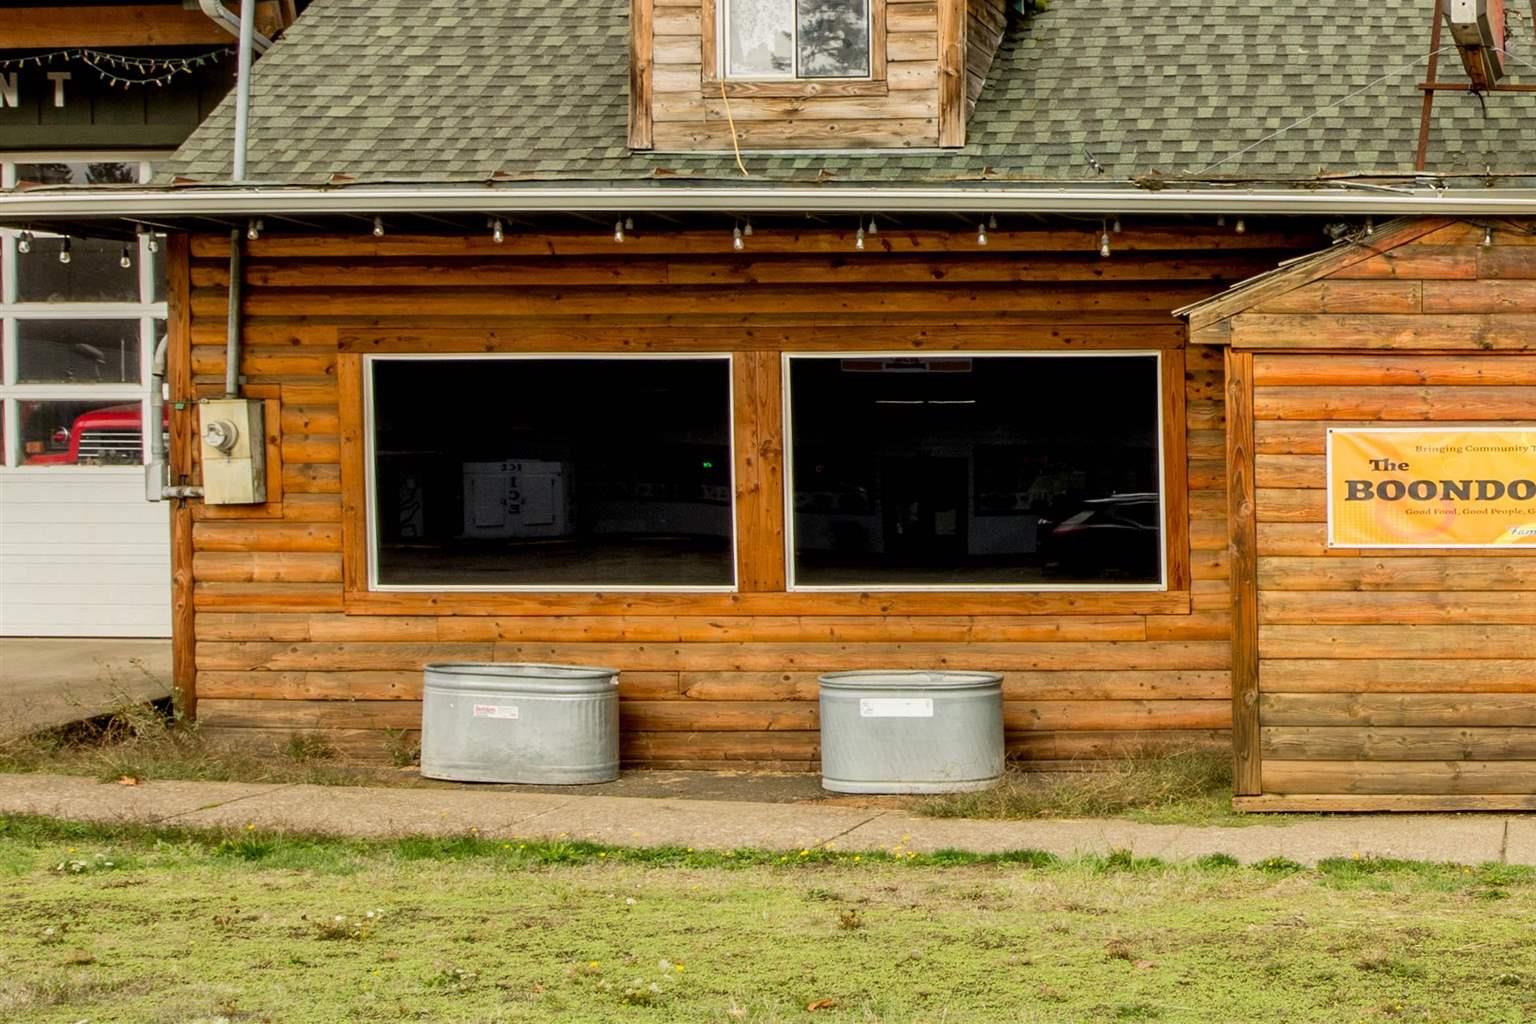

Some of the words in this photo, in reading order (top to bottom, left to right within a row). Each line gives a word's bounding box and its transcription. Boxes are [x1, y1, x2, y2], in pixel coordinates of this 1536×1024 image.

[1415, 444, 1463, 454] Bringing
[1465, 444, 1529, 454] Community
[1368, 459, 1409, 472] The
